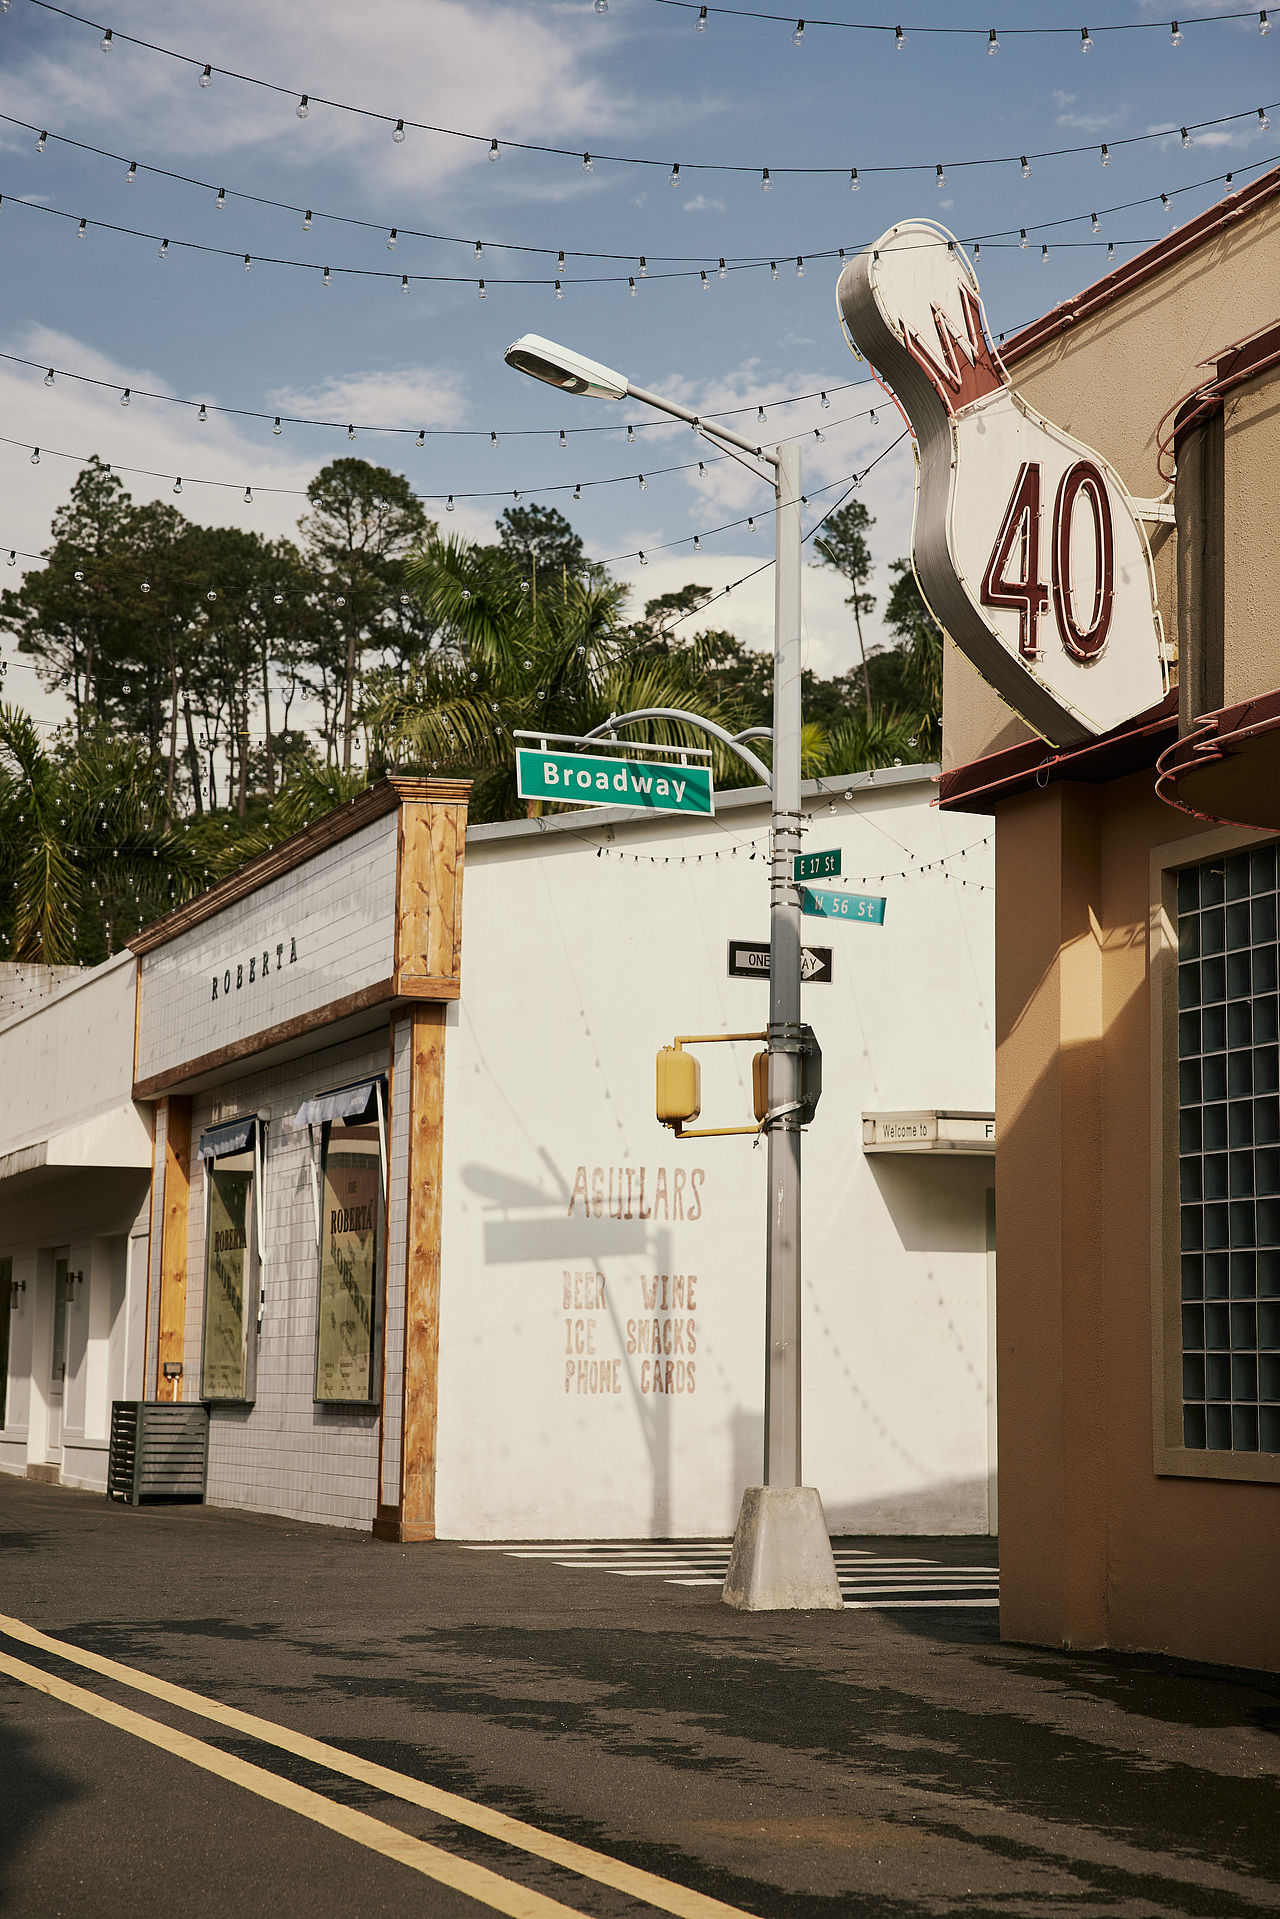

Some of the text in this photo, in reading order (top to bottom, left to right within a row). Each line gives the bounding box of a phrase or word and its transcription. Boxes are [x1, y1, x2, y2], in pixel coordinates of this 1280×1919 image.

[980, 458, 1115, 662] 40
[543, 762, 686, 803] Broadway
[800, 856, 835, 875] E 17 St
[814, 895, 875, 918] W 56 St
[212, 937, 298, 1001] ROBERTA
[748, 953, 771, 967] ONE
[882, 1123, 995, 1138] Welcome to F
[567, 1166, 705, 1221] AGUILARS
[330, 1205, 373, 1235] ROBERTA
[214, 1226, 248, 1253] ROBERTA
[562, 1270, 698, 1311] BEER WINE
[564, 1318, 697, 1355] ICE SNACKS
[565, 1359, 696, 1395] PHONE CARDS
